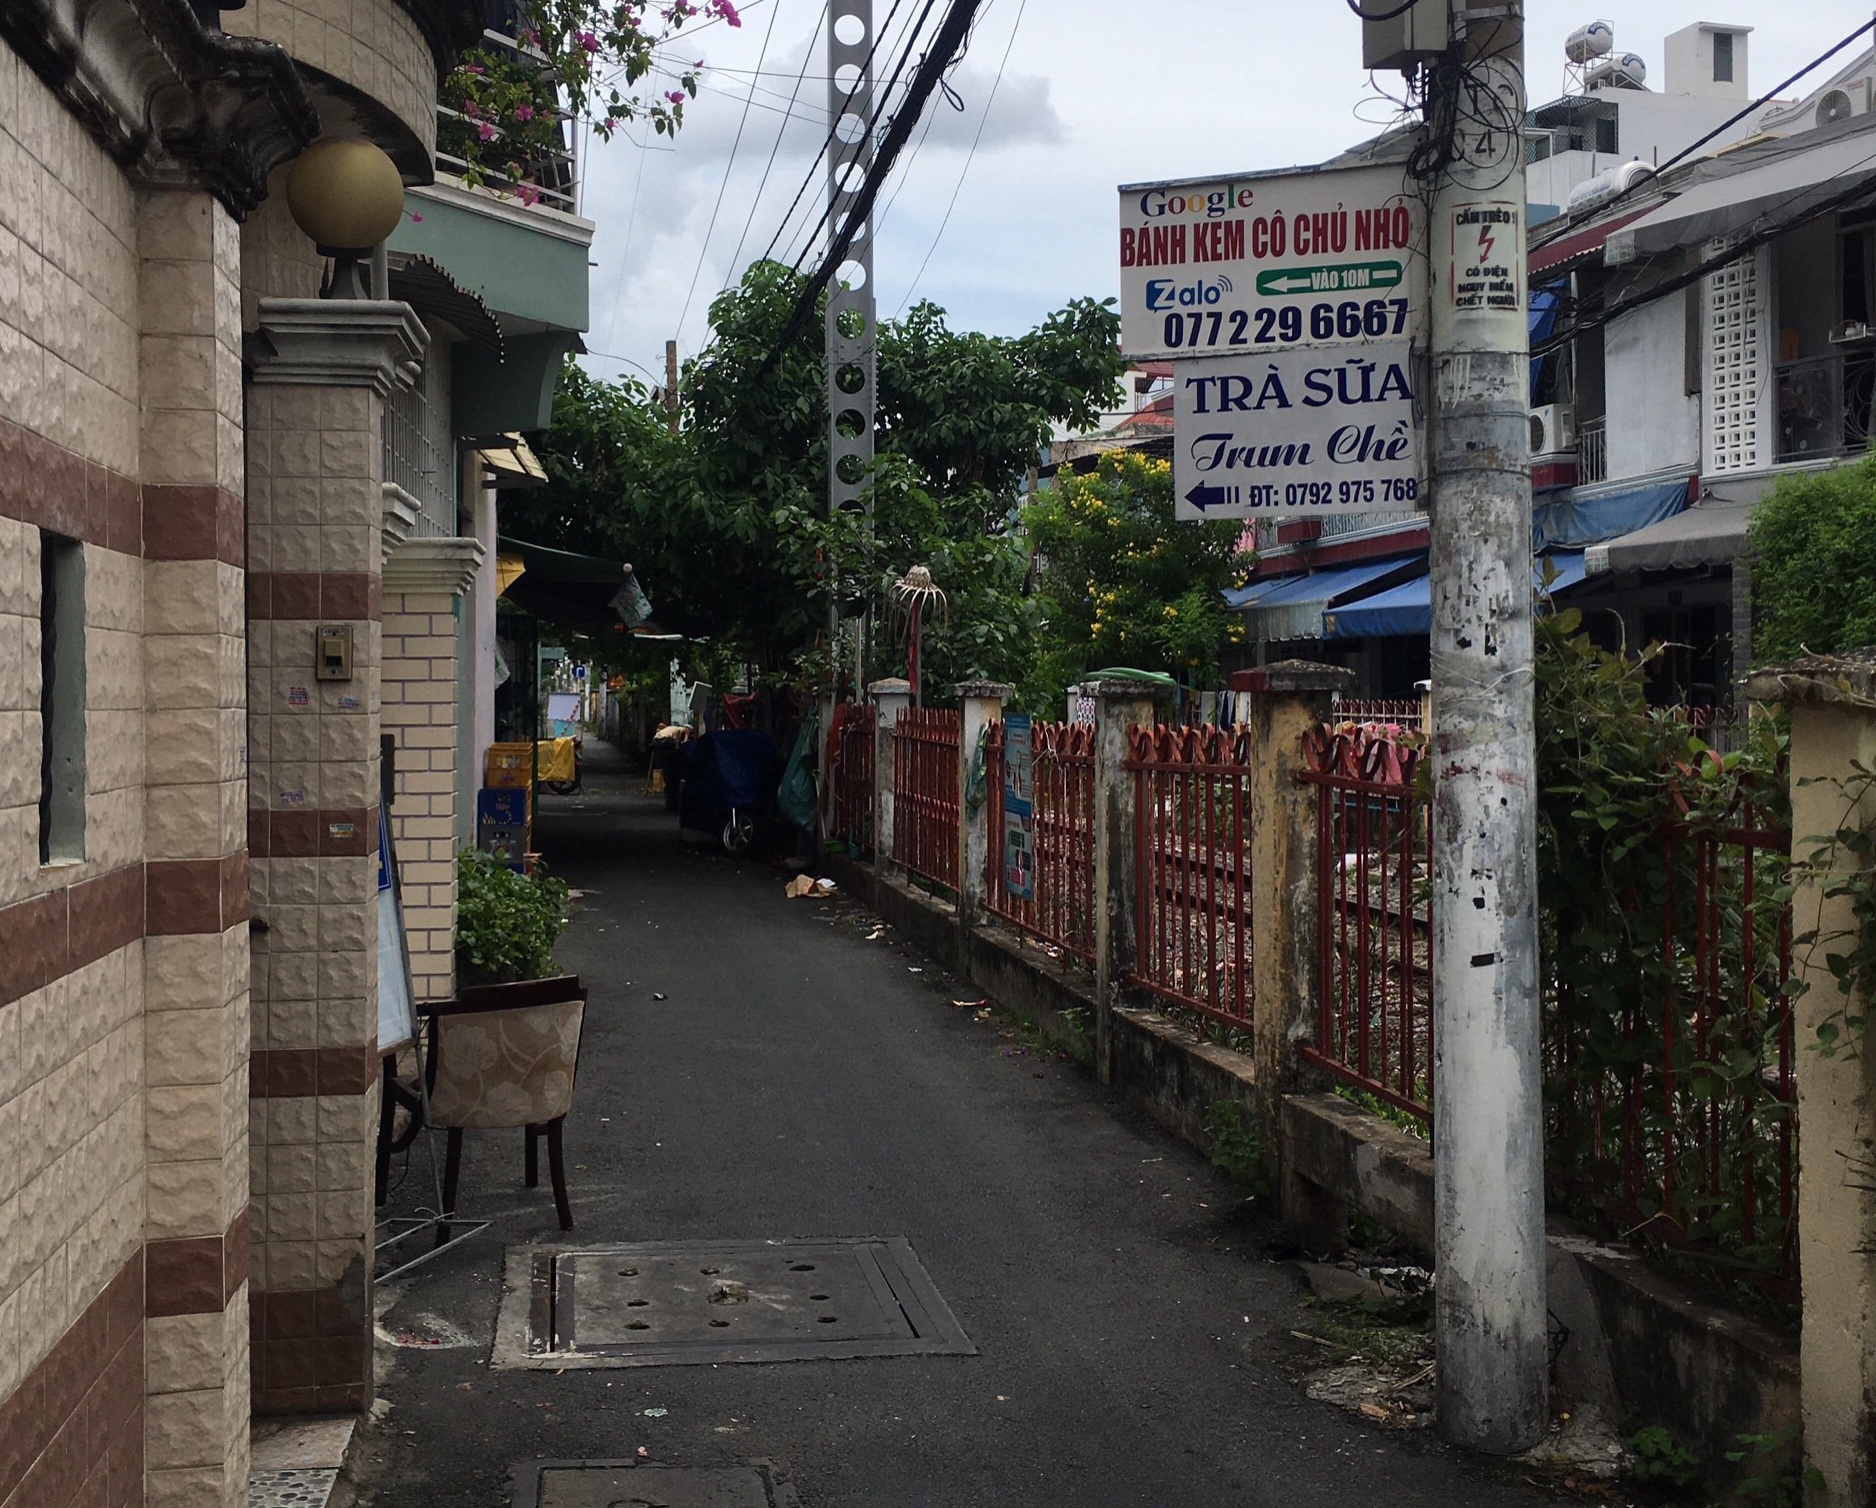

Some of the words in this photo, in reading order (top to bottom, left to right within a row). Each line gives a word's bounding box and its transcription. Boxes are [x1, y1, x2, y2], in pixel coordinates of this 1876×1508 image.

[1140, 184, 1253, 218] Google
[1120, 221, 1186, 267] BÁNH
[1193, 219, 1244, 263] KEM
[1252, 209, 1286, 260] CÔ
[1294, 202, 1347, 256] CHỦ
[1355, 198, 1409, 250] NHỎ
[1147, 278, 1221, 312] Zalo
[1311, 268, 1339, 290] VÀO
[1341, 268, 1370, 288] 10M
[1185, 363, 1293, 414] TRÀ
[1302, 358, 1414, 407] SỮA
[1191, 433, 1315, 471] Trum
[1249, 484, 1279, 507] ĐT:
[1285, 482, 1332, 506] 0792
[1338, 480, 1374, 504] 975
[1381, 477, 1417, 501] 768
